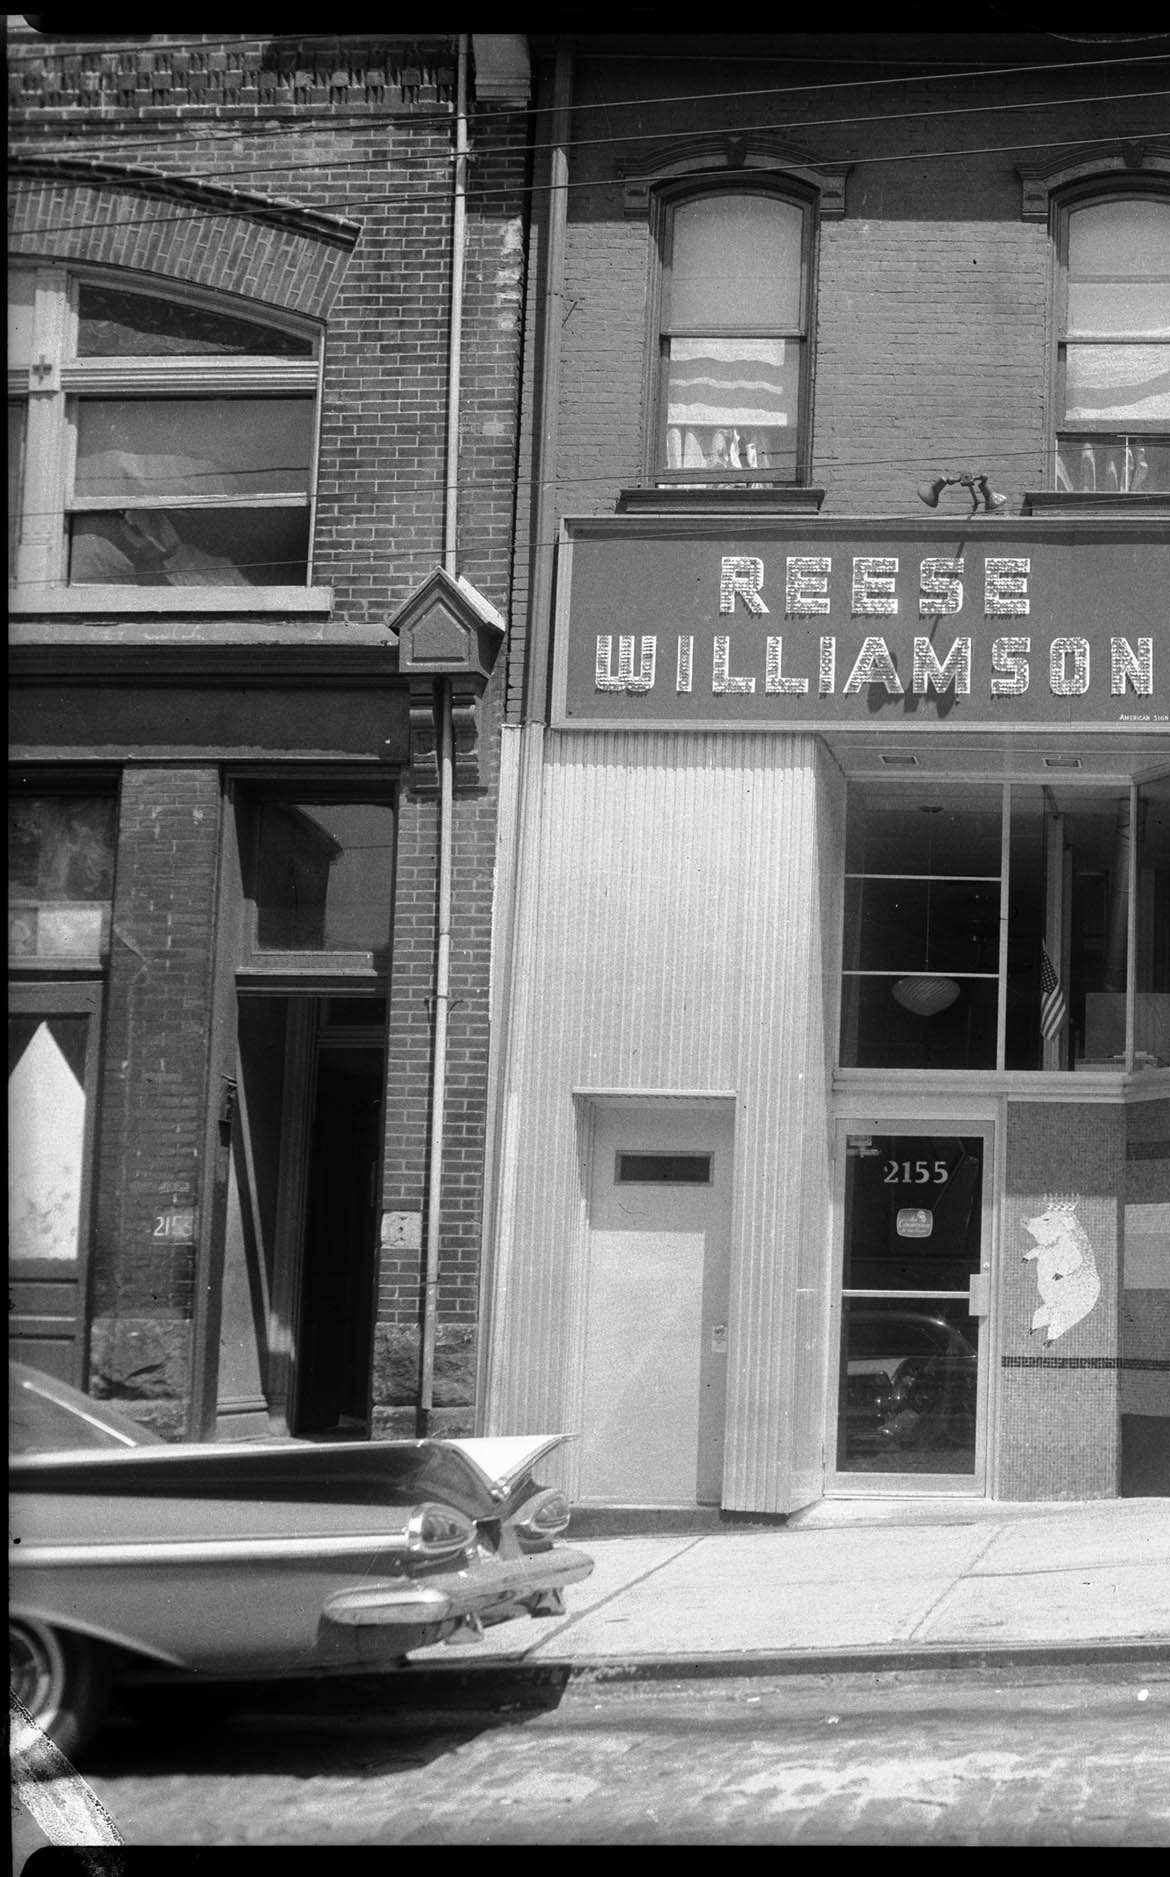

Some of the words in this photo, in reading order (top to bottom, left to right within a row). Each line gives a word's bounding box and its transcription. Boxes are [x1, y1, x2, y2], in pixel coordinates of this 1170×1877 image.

[719, 556, 1031, 615] REESE
[595, 635, 1153, 695] WILLIAMSON
[883, 1160, 949, 1184] 2155
